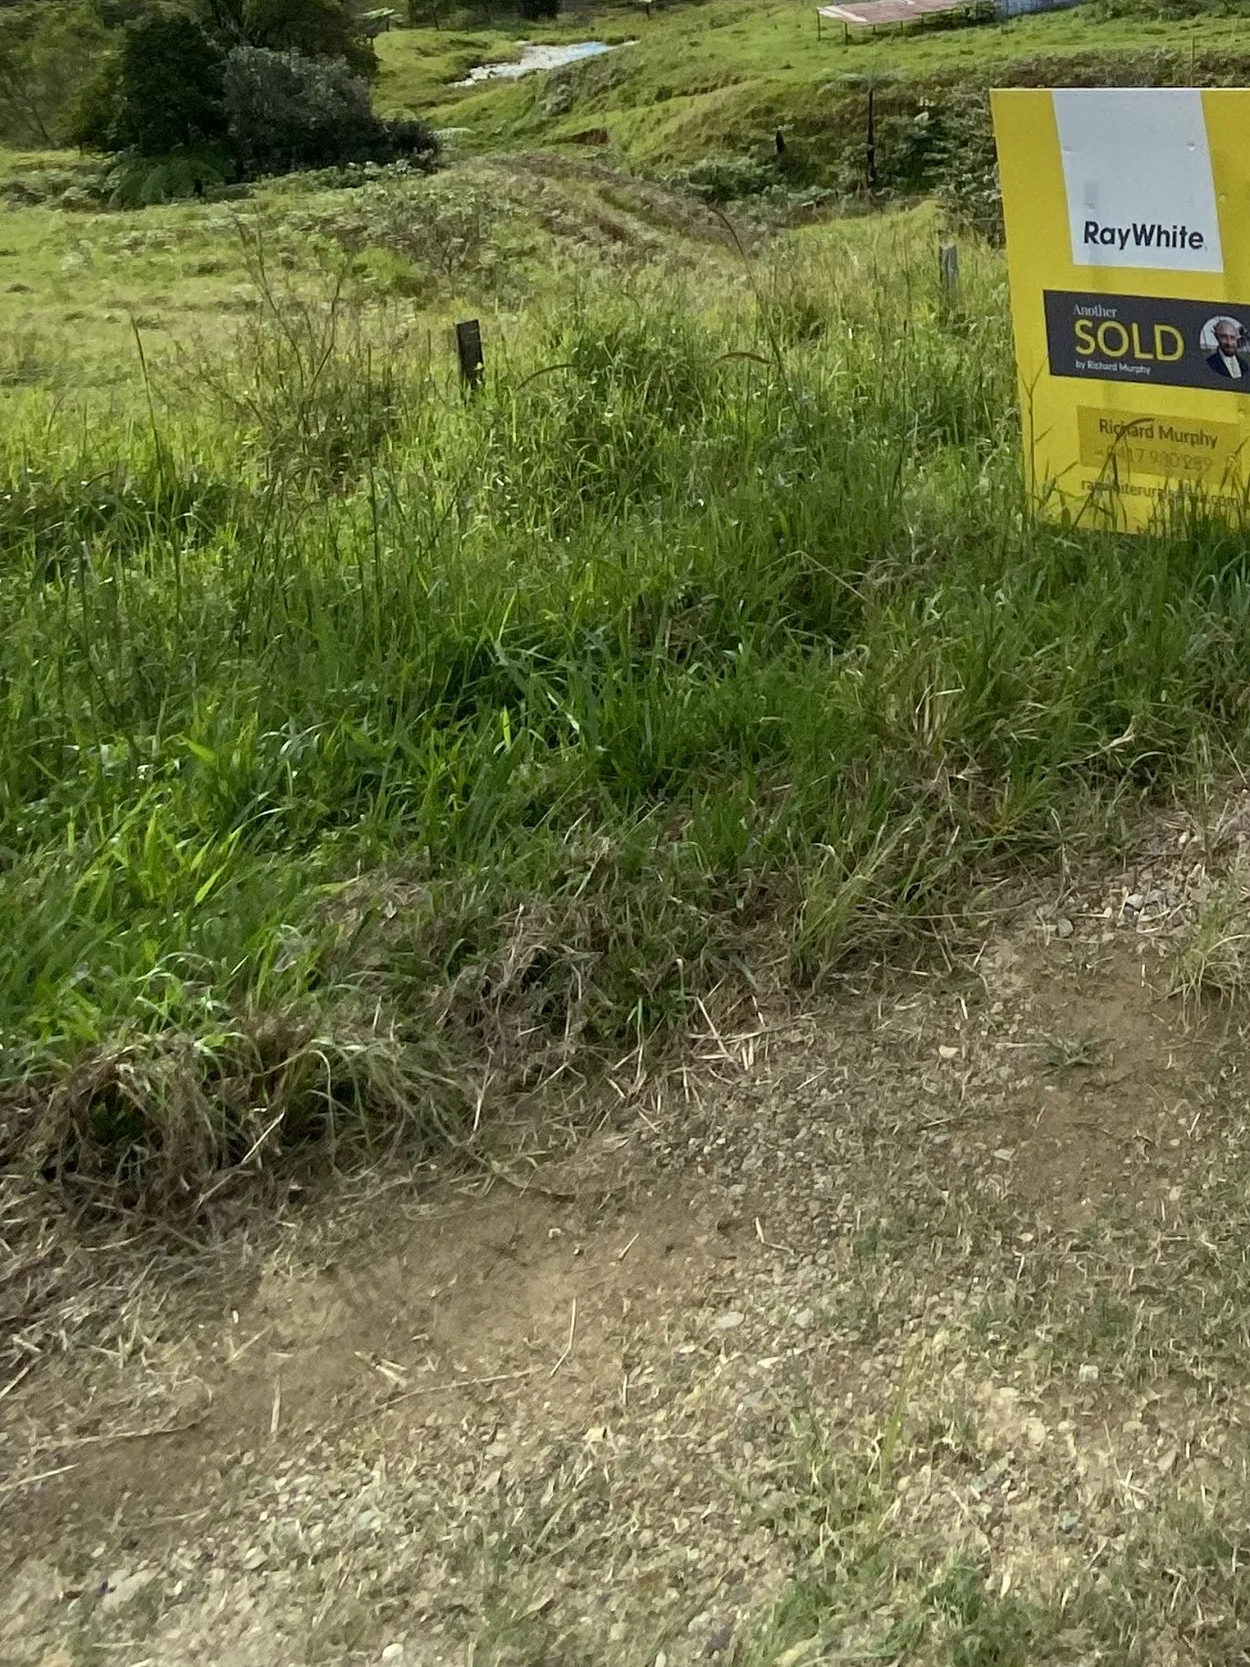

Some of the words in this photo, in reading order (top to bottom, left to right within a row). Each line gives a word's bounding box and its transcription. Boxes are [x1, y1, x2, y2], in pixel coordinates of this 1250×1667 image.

[1073, 304, 1118, 318] Another
[1074, 319, 1184, 361] SOLD
[1075, 360, 1085, 370] by
[1087, 360, 1118, 372] Richard
[1119, 362, 1152, 375] Murphy
[1158, 425, 1218, 449] Murphy
